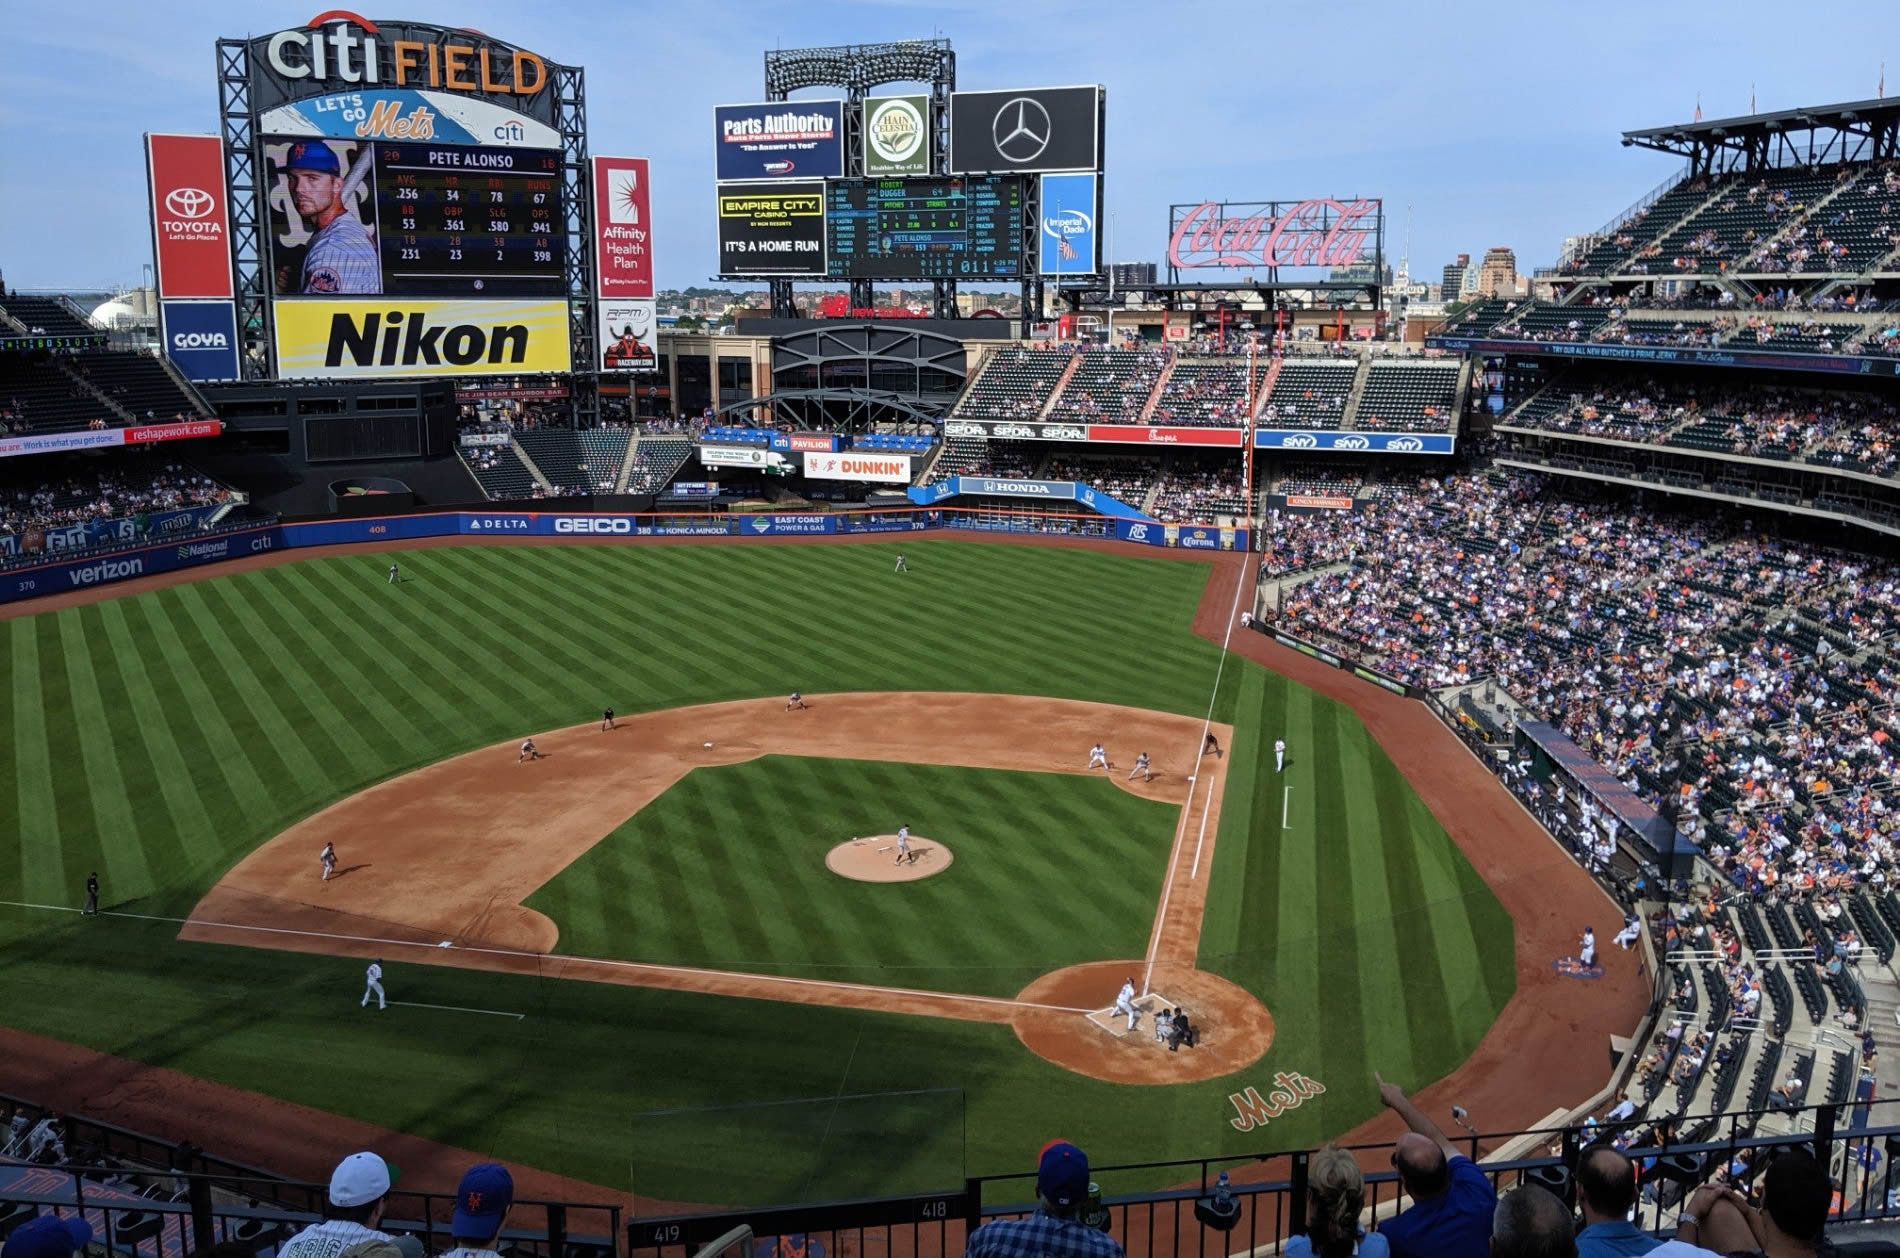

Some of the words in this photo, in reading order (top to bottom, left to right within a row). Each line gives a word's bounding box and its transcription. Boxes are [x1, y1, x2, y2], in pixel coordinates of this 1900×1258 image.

[268, 22, 379, 83] citi
[394, 40, 548, 95] FIELD
[315, 94, 363, 113] LET'S
[343, 107, 366, 122] GO
[356, 100, 435, 139] Mets
[884, 115, 909, 125] HAIN
[724, 119, 762, 136] Parts
[764, 112, 834, 133] Authority
[872, 122, 921, 134] CELESTIAL
[494, 121, 524, 142] citi
[384, 152, 400, 161] 20
[429, 151, 461, 166] PETE
[464, 153, 514, 168] ALONSO
[396, 175, 416, 185] AVG
[396, 188, 418, 200] .256
[446, 190, 460, 200] 34
[490, 192, 503, 202] 78
[533, 194, 546, 204] 67
[880, 189, 907, 197] DUGGER
[725, 201, 780, 211] EMPIRE
[783, 200, 813, 210] CITY
[489, 208, 506, 218] SLG
[532, 209, 550, 219] OPS
[162, 221, 222, 233] TOYOTA
[402, 218, 416, 230] 53
[443, 219, 465, 231] .361
[488, 221, 509, 232] .580
[531, 222, 552, 233] .941
[1048, 217, 1083, 228] Imperial
[603, 227, 647, 243] Affinity
[1063, 225, 1086, 234] Dade
[1169, 198, 1383, 268] Coca-Cola
[404, 235, 416, 245] TB
[536, 238, 548, 248] AB
[606, 242, 644, 254] Health
[725, 241, 746, 252] IT'S
[748, 241, 756, 252] A
[759, 241, 793, 252] HOME
[795, 240, 819, 252] RUN
[401, 249, 420, 260] 231
[450, 250, 463, 260] 23
[497, 250, 503, 261] 2
[533, 251, 552, 262] 398
[613, 257, 638, 269] Plan
[174, 334, 229, 348] GOYA
[325, 311, 530, 368] Nikon
[511, 389, 546, 397] BOURBON
[133, 424, 211, 442] reshapework.com
[23, 440, 42, 450] Work
[44, 439, 50, 447] is
[50, 437, 69, 447] what
[69, 436, 84, 447] you
[84, 434, 96, 445] get
[774, 437, 788, 448] citi
[793, 440, 830, 449] PAVILION
[1282, 436, 1313, 448] SNY
[1334, 438, 1365, 449] SNY
[1386, 440, 1419, 451] SNY
[841, 460, 904, 476] DUNKIN'
[996, 483, 1050, 494] HONDA
[484, 519, 528, 529] DELTA
[555, 518, 631, 533] GEICO
[799, 516, 825, 524] COAST
[912, 522, 925, 530] 370
[637, 527, 651, 535] 380
[666, 527, 695, 535] KONICA
[696, 527, 728, 535] MINOLTA
[809, 524, 825, 532] GAS
[1129, 524, 1149, 539] RTS
[189, 539, 228, 556] National
[251, 535, 272, 551] citi
[1182, 536, 1215, 547] Corona
[69, 557, 143, 586] verizon
[19, 580, 35, 592] 370
[1228, 1071, 1327, 1132] Mets
[921, 1201, 948, 1218] 418
[654, 1226, 680, 1243] 419
